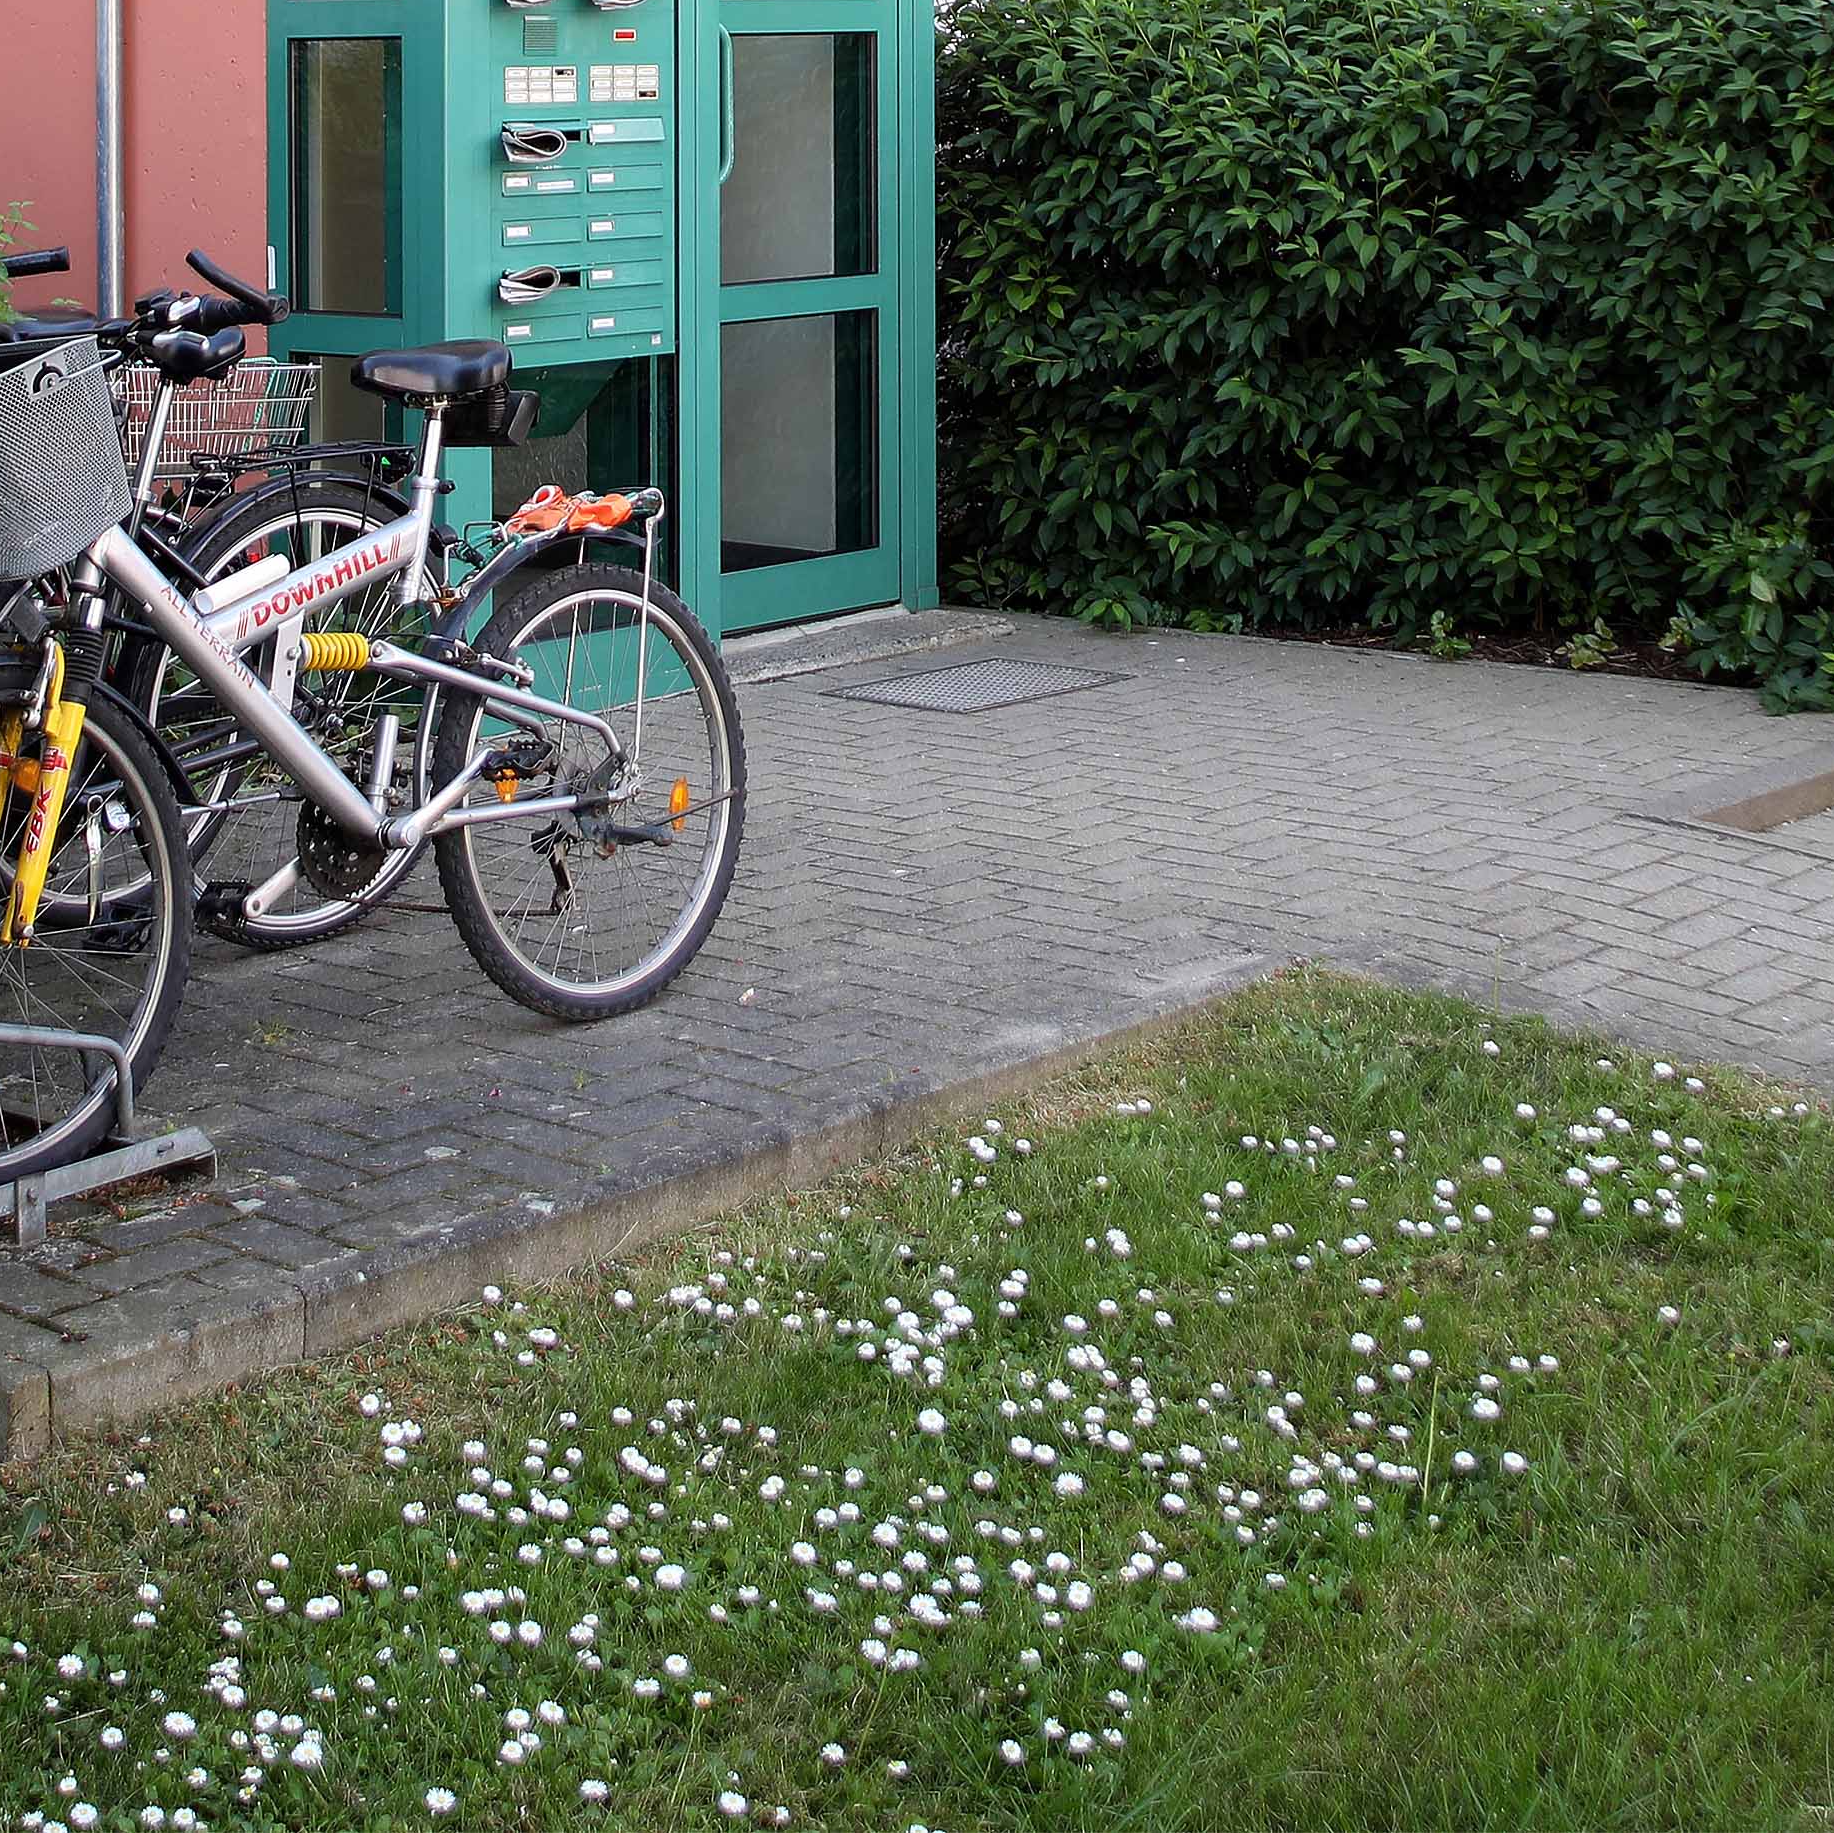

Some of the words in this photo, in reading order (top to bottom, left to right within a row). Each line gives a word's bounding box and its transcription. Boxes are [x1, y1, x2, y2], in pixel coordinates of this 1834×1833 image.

[251, 544, 388, 627] DOWNHILL
[160, 585, 189, 618] ALL
[191, 617, 255, 689] TERRAIN
